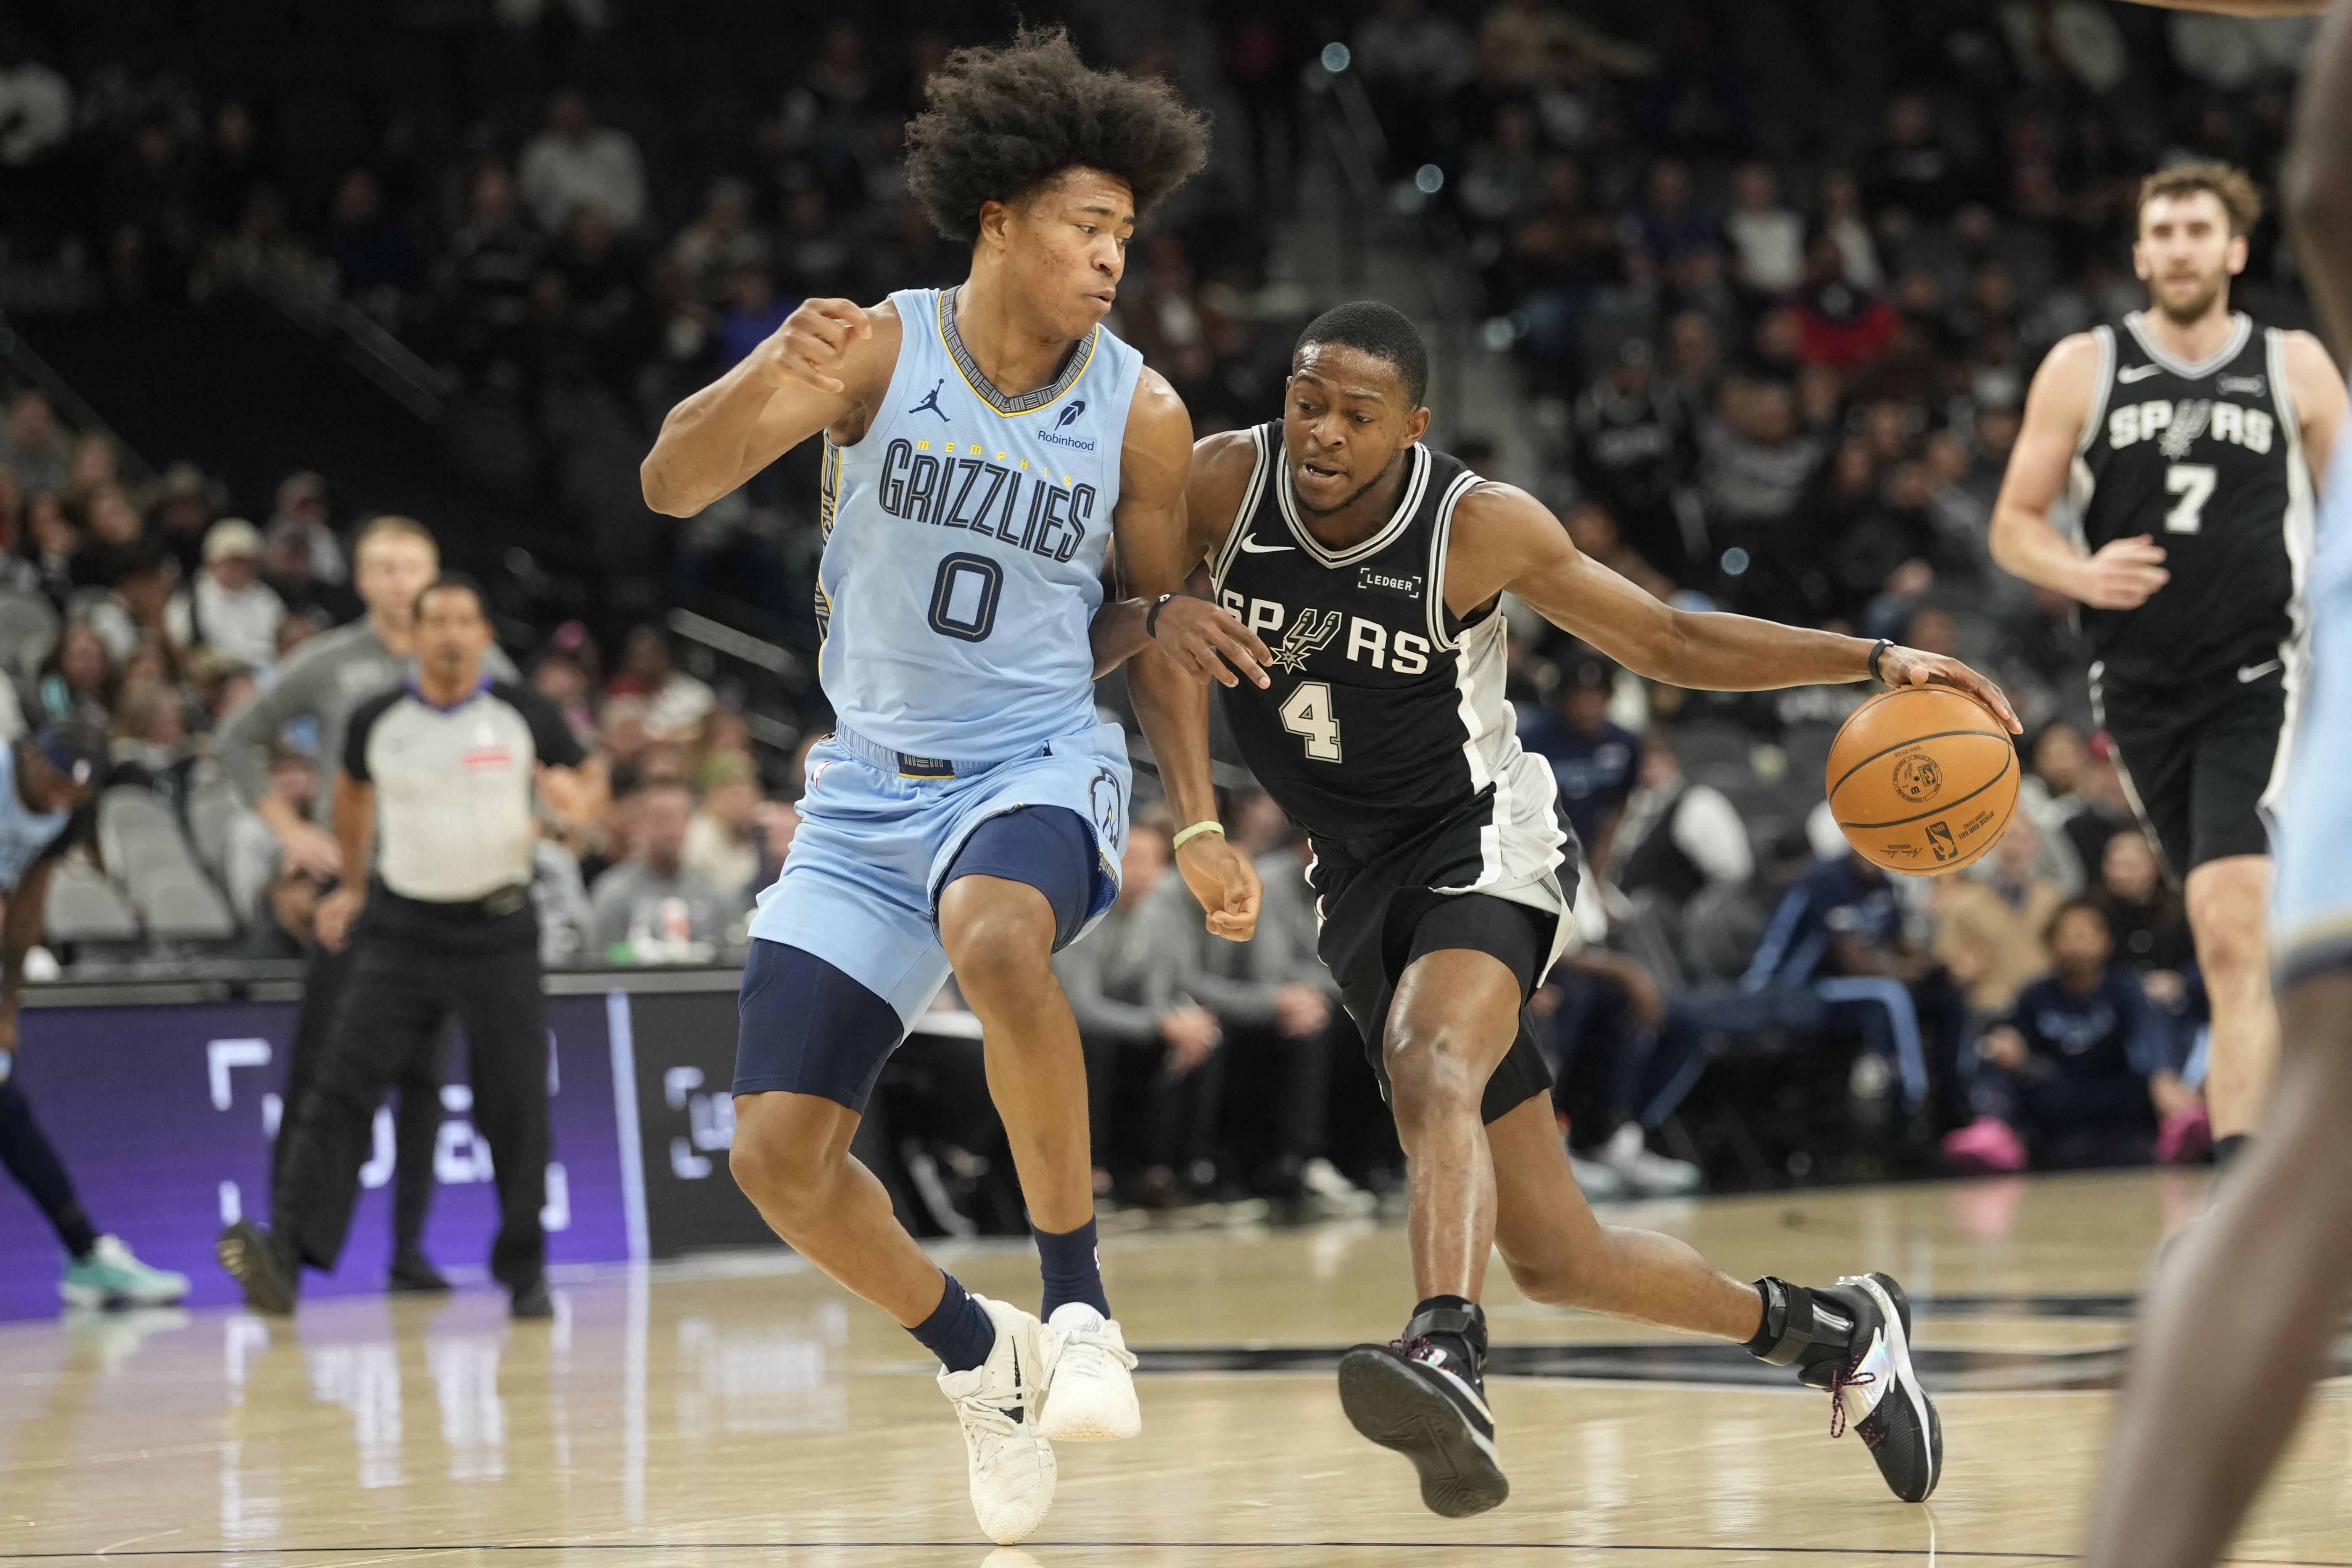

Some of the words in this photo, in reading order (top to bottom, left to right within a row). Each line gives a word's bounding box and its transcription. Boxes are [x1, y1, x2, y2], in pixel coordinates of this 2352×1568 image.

[1038, 430, 1094, 451] Robinhood
[2107, 399, 2273, 460] SPURS
[917, 440, 1072, 486] MEMPHIS
[879, 438, 1096, 563] GRIZZLIES
[2164, 463, 2217, 534] 7
[928, 552, 1004, 643] 0
[1367, 574, 1412, 591] LEDGER
[1278, 681, 1342, 763] 4
[1959, 830, 1969, 839] BALL
[1969, 823, 1980, 834] GAME
[1979, 810, 1994, 826] OFFICIAL
